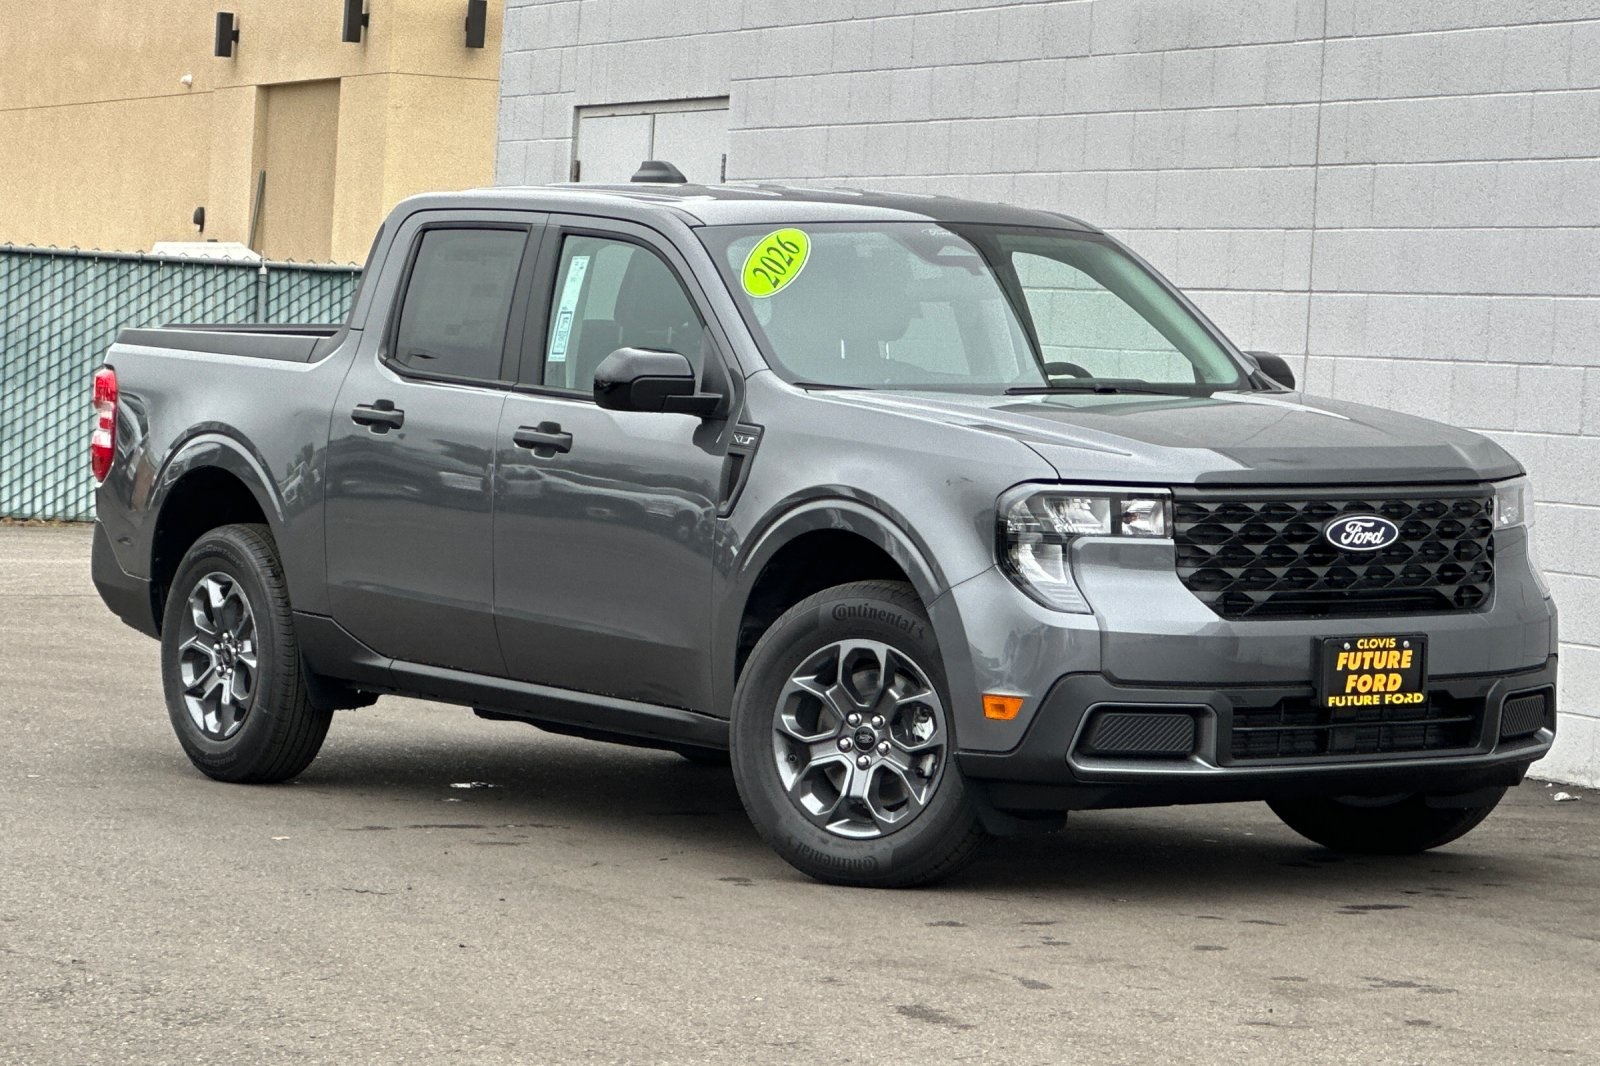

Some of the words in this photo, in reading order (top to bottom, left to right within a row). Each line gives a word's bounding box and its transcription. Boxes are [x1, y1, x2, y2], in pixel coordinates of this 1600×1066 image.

[753, 235, 800, 288] 2026
[1341, 521, 1385, 544] Ford
[832, 603, 916, 633] Continental
[1357, 638, 1396, 649] CLOVIS
[1336, 650, 1413, 671] FUTURE
[1345, 673, 1402, 693] FORD
[1328, 694, 1381, 707] FUTURE
[1385, 693, 1424, 705] FORD
